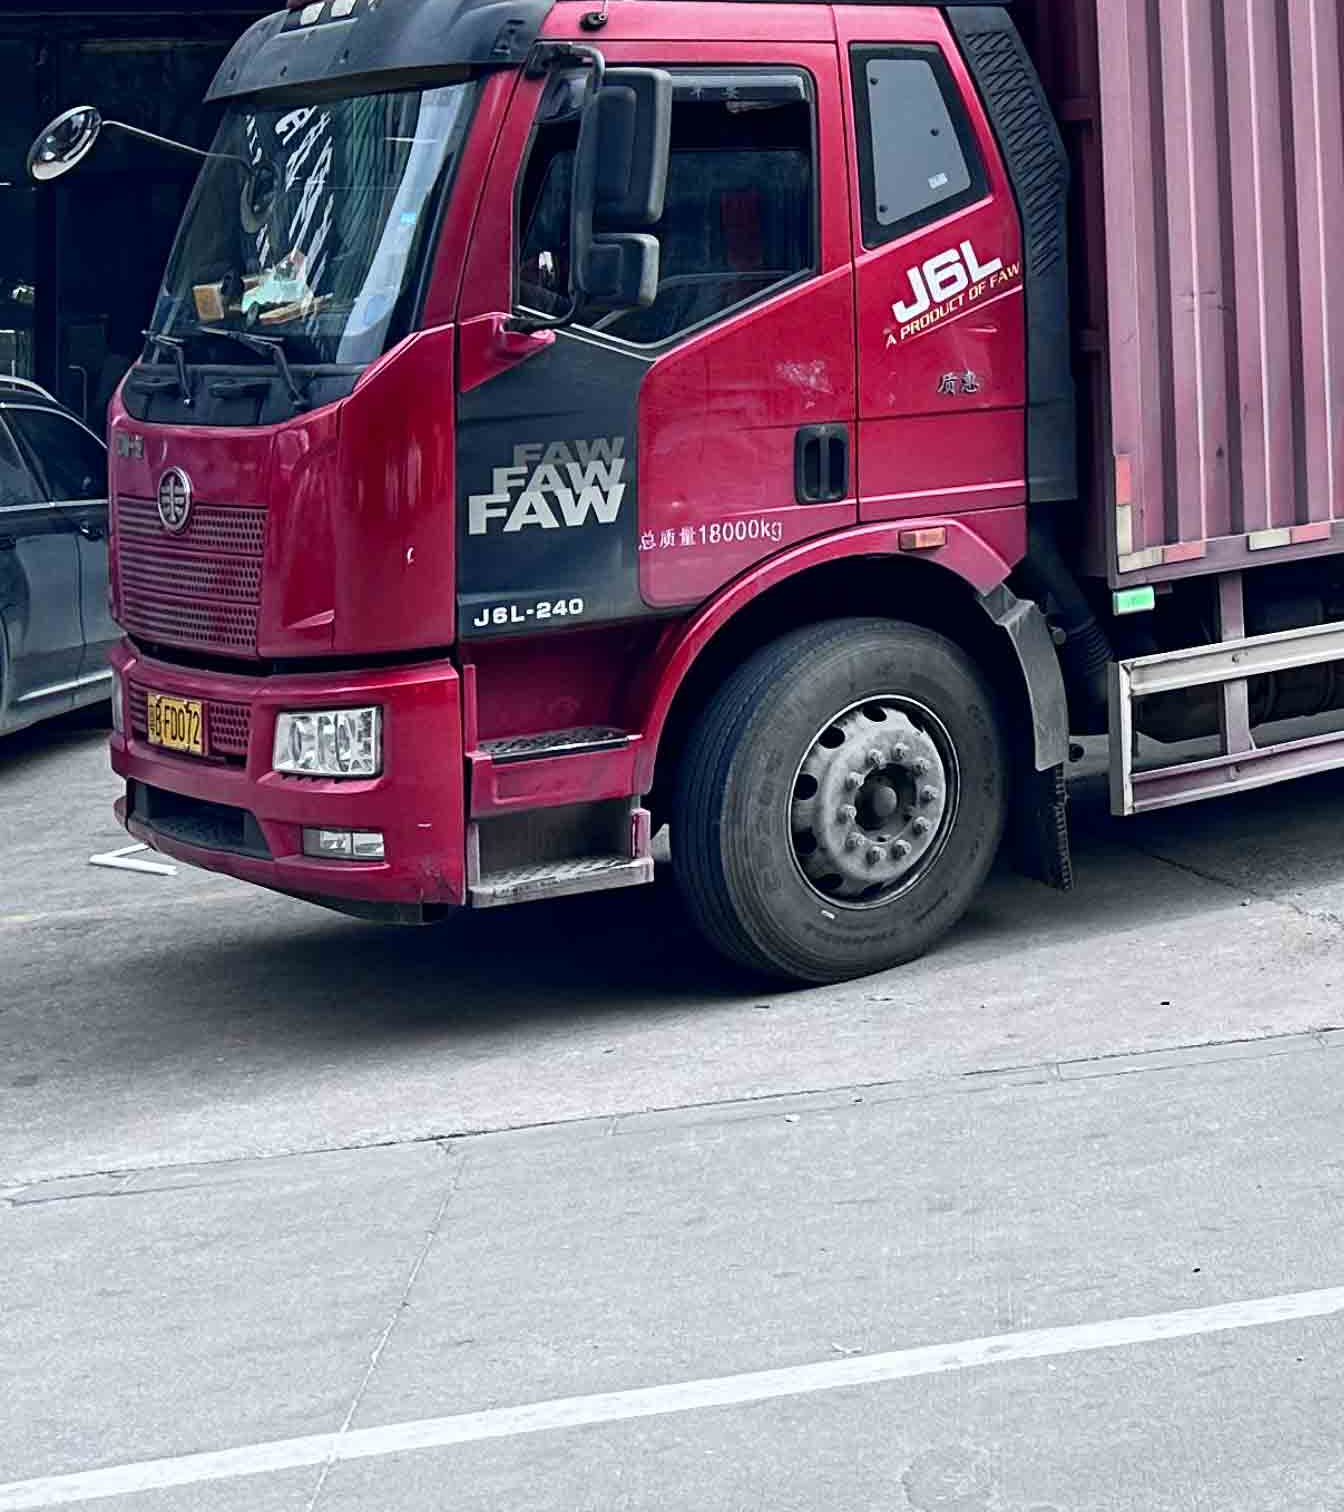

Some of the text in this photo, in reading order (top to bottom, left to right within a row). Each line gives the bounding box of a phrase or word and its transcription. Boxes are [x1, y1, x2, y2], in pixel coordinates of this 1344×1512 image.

[891, 239, 1003, 324] J6L
[885, 261, 1021, 349] A PRODUCT OF FAW
[512, 436, 626, 468] FAW
[492, 457, 626, 496] FAW
[467, 483, 626, 536] FAW
[473, 598, 584, 628] J6L-240
